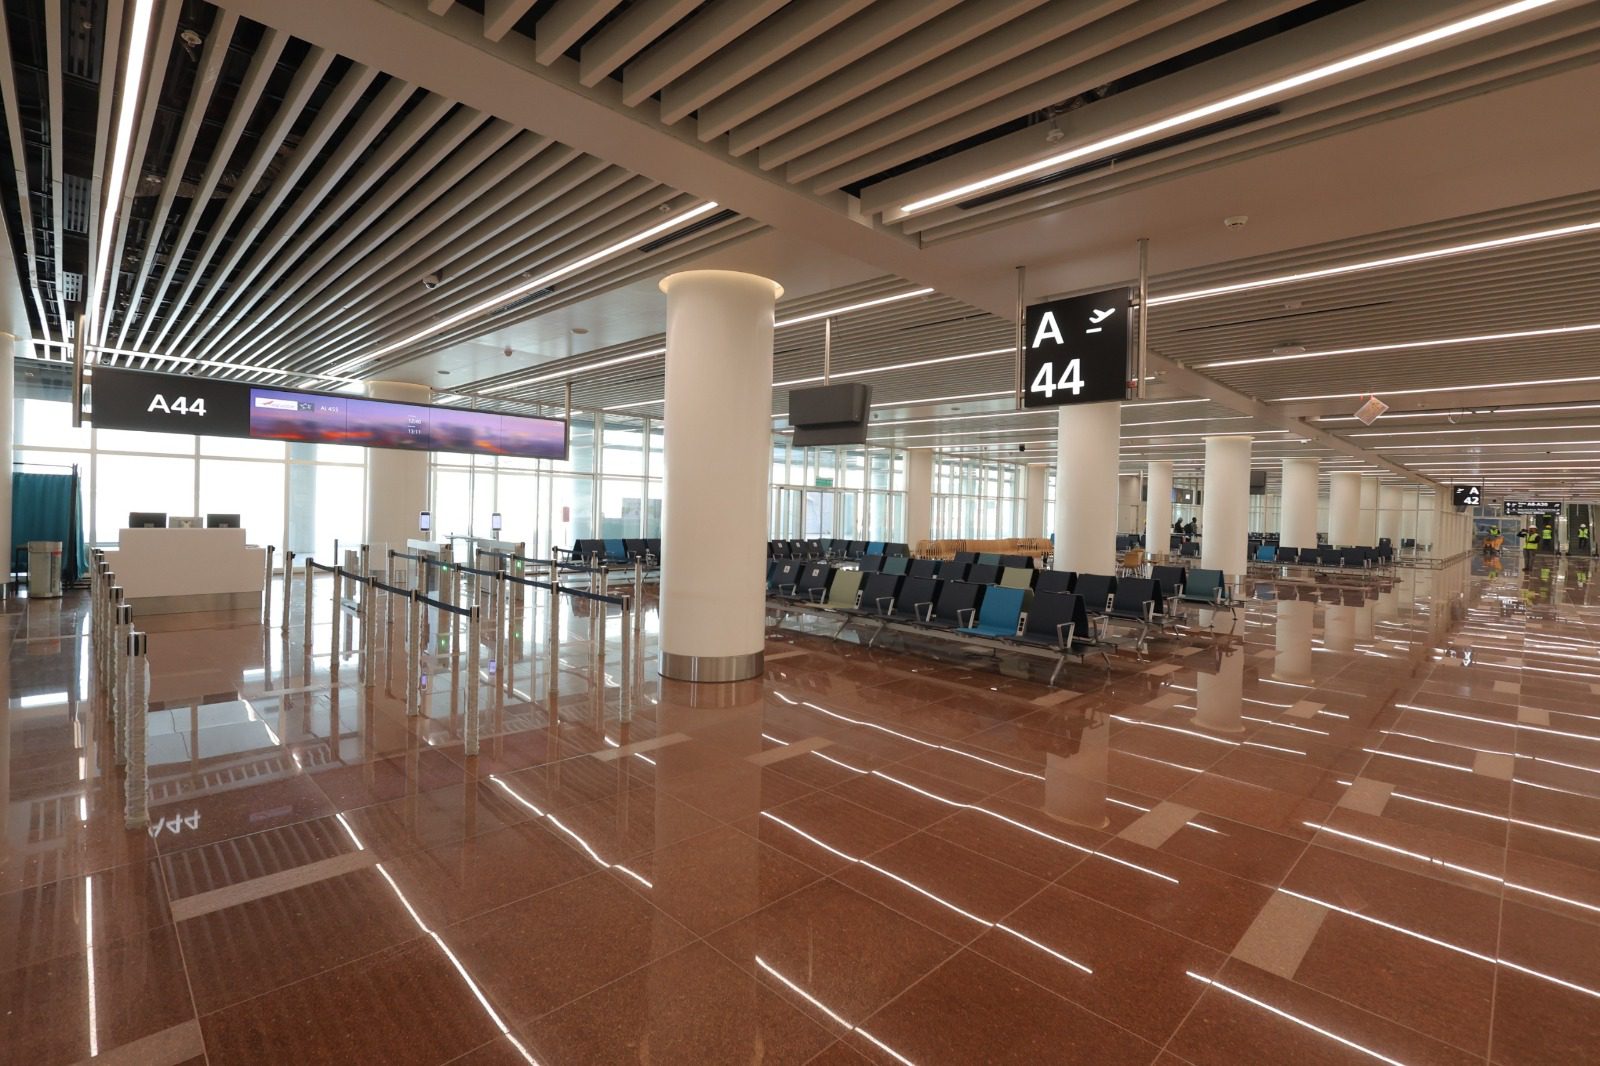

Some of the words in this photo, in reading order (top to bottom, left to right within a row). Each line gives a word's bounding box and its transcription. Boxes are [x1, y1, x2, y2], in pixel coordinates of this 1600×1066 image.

[1031, 311, 1064, 348] A
[1030, 358, 1085, 398] 44
[147, 393, 208, 416] A44
[1463, 496, 1479, 504] 42
[1469, 487, 1480, 495] A
